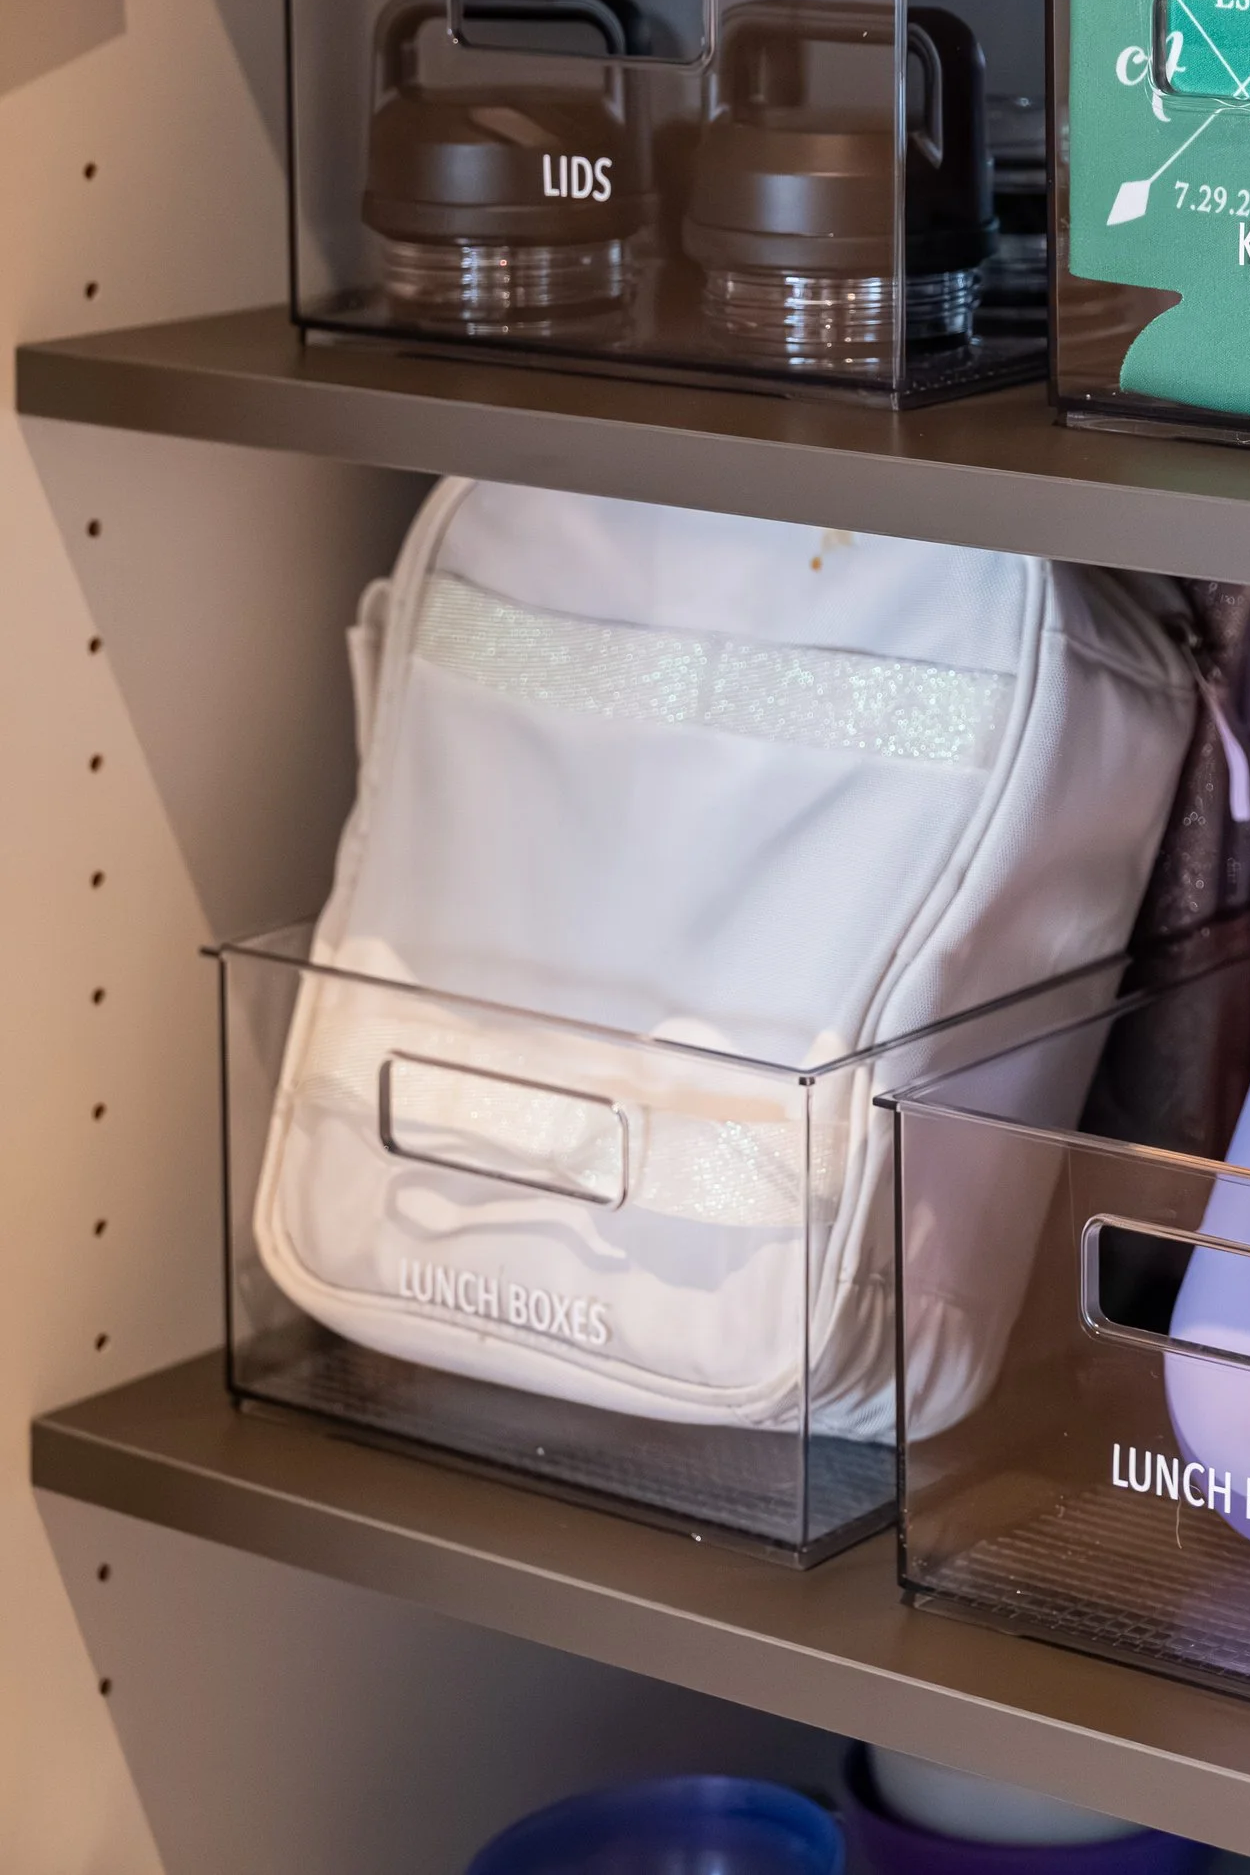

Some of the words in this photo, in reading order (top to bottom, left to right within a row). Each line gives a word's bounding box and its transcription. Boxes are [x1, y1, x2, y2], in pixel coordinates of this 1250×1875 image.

[542, 153, 613, 203] LIDS
[400, 1257, 500, 1319] LUNCH
[508, 1281, 609, 1346] BOXES
[1112, 1442, 1232, 1514] LUNCH
